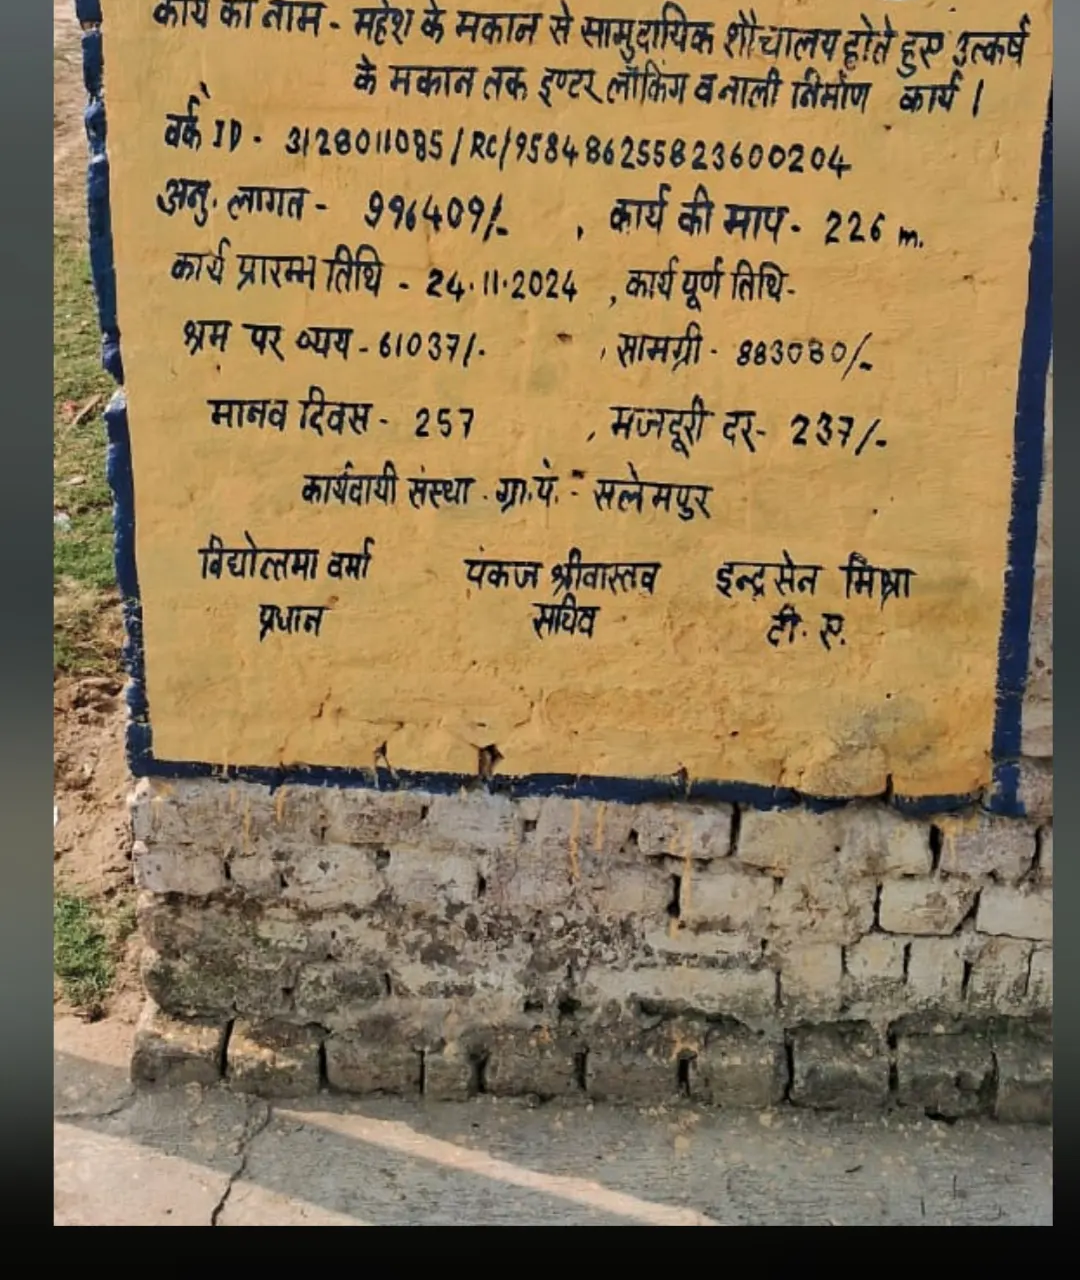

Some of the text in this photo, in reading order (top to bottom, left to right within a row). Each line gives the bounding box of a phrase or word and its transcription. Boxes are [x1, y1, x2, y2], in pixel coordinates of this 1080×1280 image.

[456, 10, 542, 46] मकान
[550, 0, 575, 46] से
[580, 1, 714, 62] सामुदायिक
[952, 13, 1030, 68] उत्कर्ष
[353, 54, 376, 95] के
[388, 64, 478, 100] मकान
[483, 66, 528, 100] तक
[538, 67, 602, 107] इण्टर
[718, 67, 783, 108] नाली
[791, 67, 873, 113] निर्माण
[899, 68, 961, 114] कार्य
[609, 183, 671, 234] कार्य
[678, 184, 714, 235] की
[824, 210, 887, 245] 226
[171, 237, 231, 285] कार्य
[236, 254, 316, 291] प्रारम्भ
[681, 256, 724, 311] पूर्ण
[183, 319, 233, 357] श्रम
[241, 323, 286, 361] पर
[207, 398, 289, 432] मानव
[415, 407, 475, 439] 257
[610, 394, 715, 458] मजदूरी
[301, 460, 398, 507] कार्यदायी
[594, 462, 713, 521] सलेमपुर
[327, 536, 376, 580] वर्मा
[464, 545, 662, 595] पंकज श्रीवास्तव
[259, 603, 332, 642] प्रधान
